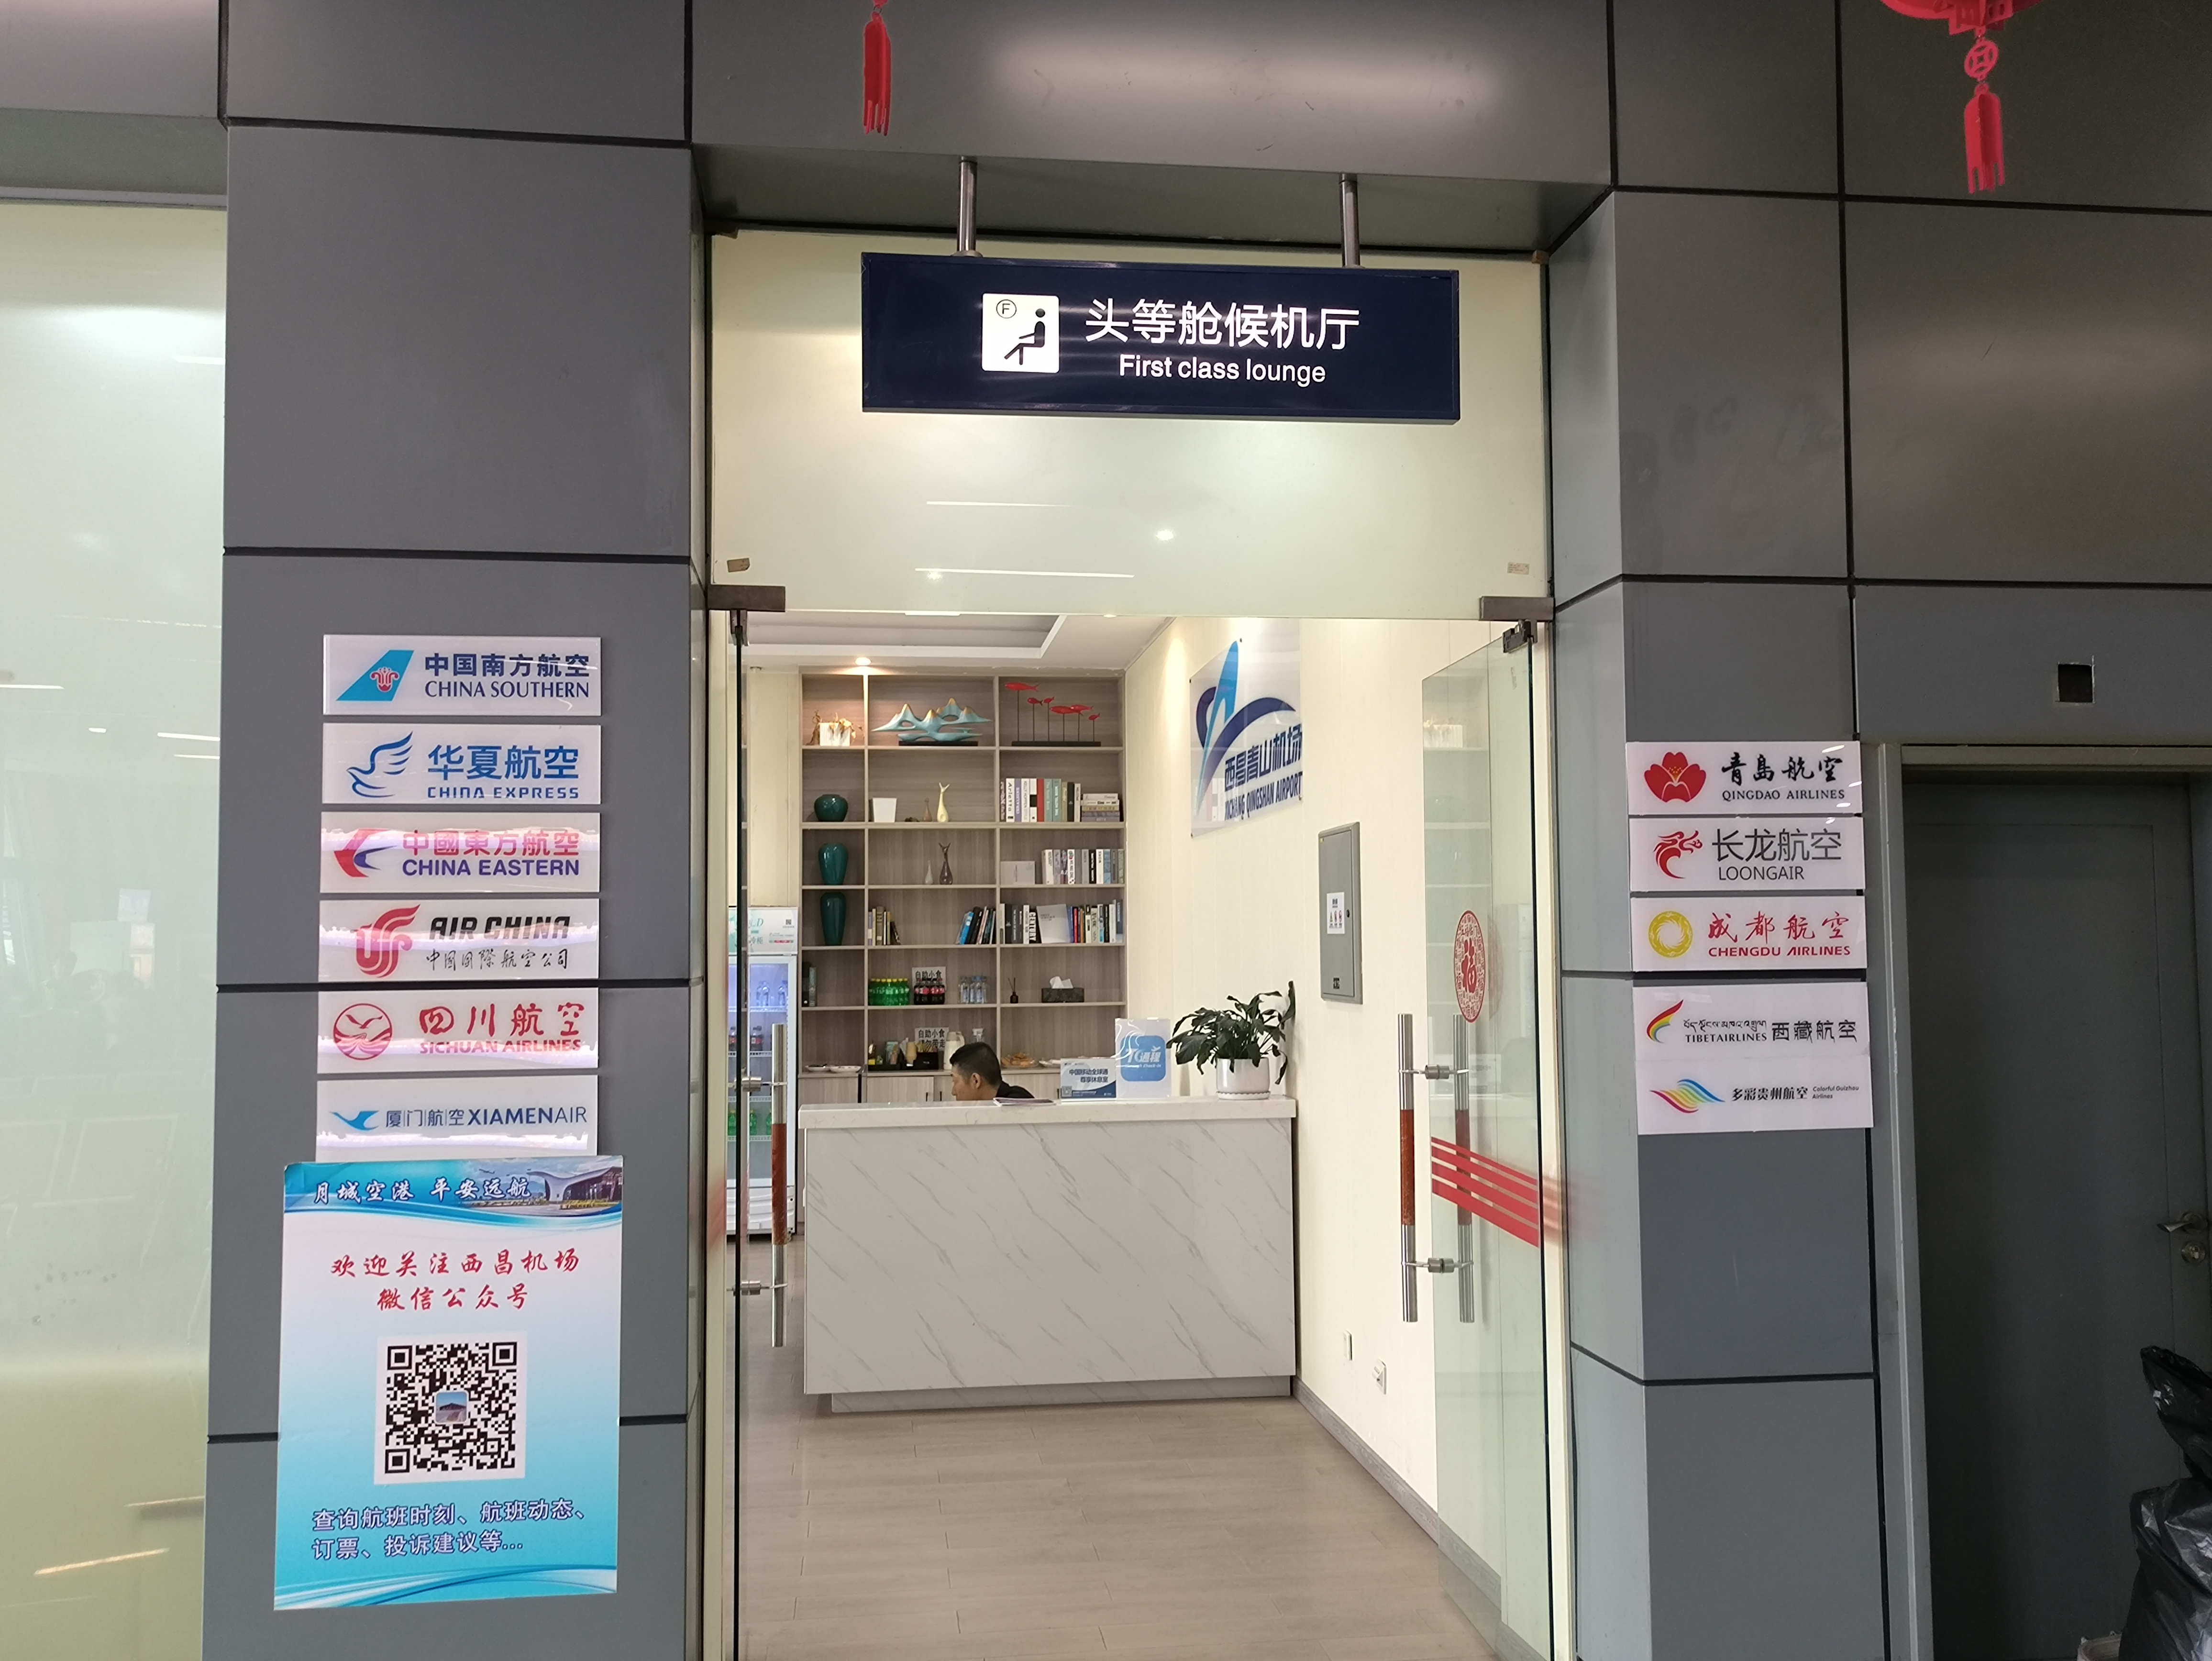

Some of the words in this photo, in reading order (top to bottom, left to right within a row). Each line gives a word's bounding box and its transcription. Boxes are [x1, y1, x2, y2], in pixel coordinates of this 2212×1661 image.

[1002, 303, 1011, 314] F
[1084, 298, 1360, 350] 头等舱候机厅
[1120, 354, 1173, 378] First
[1178, 356, 1240, 380] class
[1246, 358, 1327, 387] lounge
[424, 653, 590, 677] 中国南方航空
[425, 680, 487, 698] CHINA
[490, 680, 589, 698] SOUTHERN
[428, 744, 579, 781] 华夏航空
[1225, 723, 1302, 792] 西昌青山机场
[1721, 752, 1844, 786] 青岛航空
[428, 786, 485, 799] CHINA
[493, 786, 579, 799] EXPRESS
[1225, 792, 1245, 821] XICHANG
[1247, 783, 1274, 818] QINGSHAN
[1275, 771, 1303, 803] AIRPORT
[1722, 789, 1781, 802] QINGDAO
[1786, 789, 1845, 800] AIRLINES
[402, 829, 580, 856] 中國東方航空
[1712, 828, 1842, 862] 长龙航空
[402, 859, 472, 876] CHINA
[478, 859, 579, 876] EASTERN
[1718, 866, 1805, 881] LOONGAIR
[430, 917, 478, 941] AIR
[484, 916, 571, 940] CHINA
[1708, 911, 1849, 944] 成都航空
[1708, 947, 1781, 957] CHENGDU
[1787, 945, 1851, 956] AIRLINES
[419, 1002, 585, 1038] 四川航空
[1771, 1019, 1858, 1044] 西藏航空
[918, 1029, 945, 1038] 自助小食
[919, 1039, 945, 1048] 勿带走
[420, 1041, 498, 1054] SICHUAN
[502, 1039, 582, 1053] AIRLINES
[1732, 1086, 1809, 1101] 多彩贵州航空
[467, 1106, 587, 1126] XIAMENAIR
[314, 1179, 415, 1205] 月城空港
[431, 1176, 532, 1202] 平安远航
[330, 1248, 580, 1278] 欢迎关注西昌机场
[377, 1283, 528, 1311] 微信公众号
[313, 1497, 586, 1532] 查询航班时刻、航班动态、
